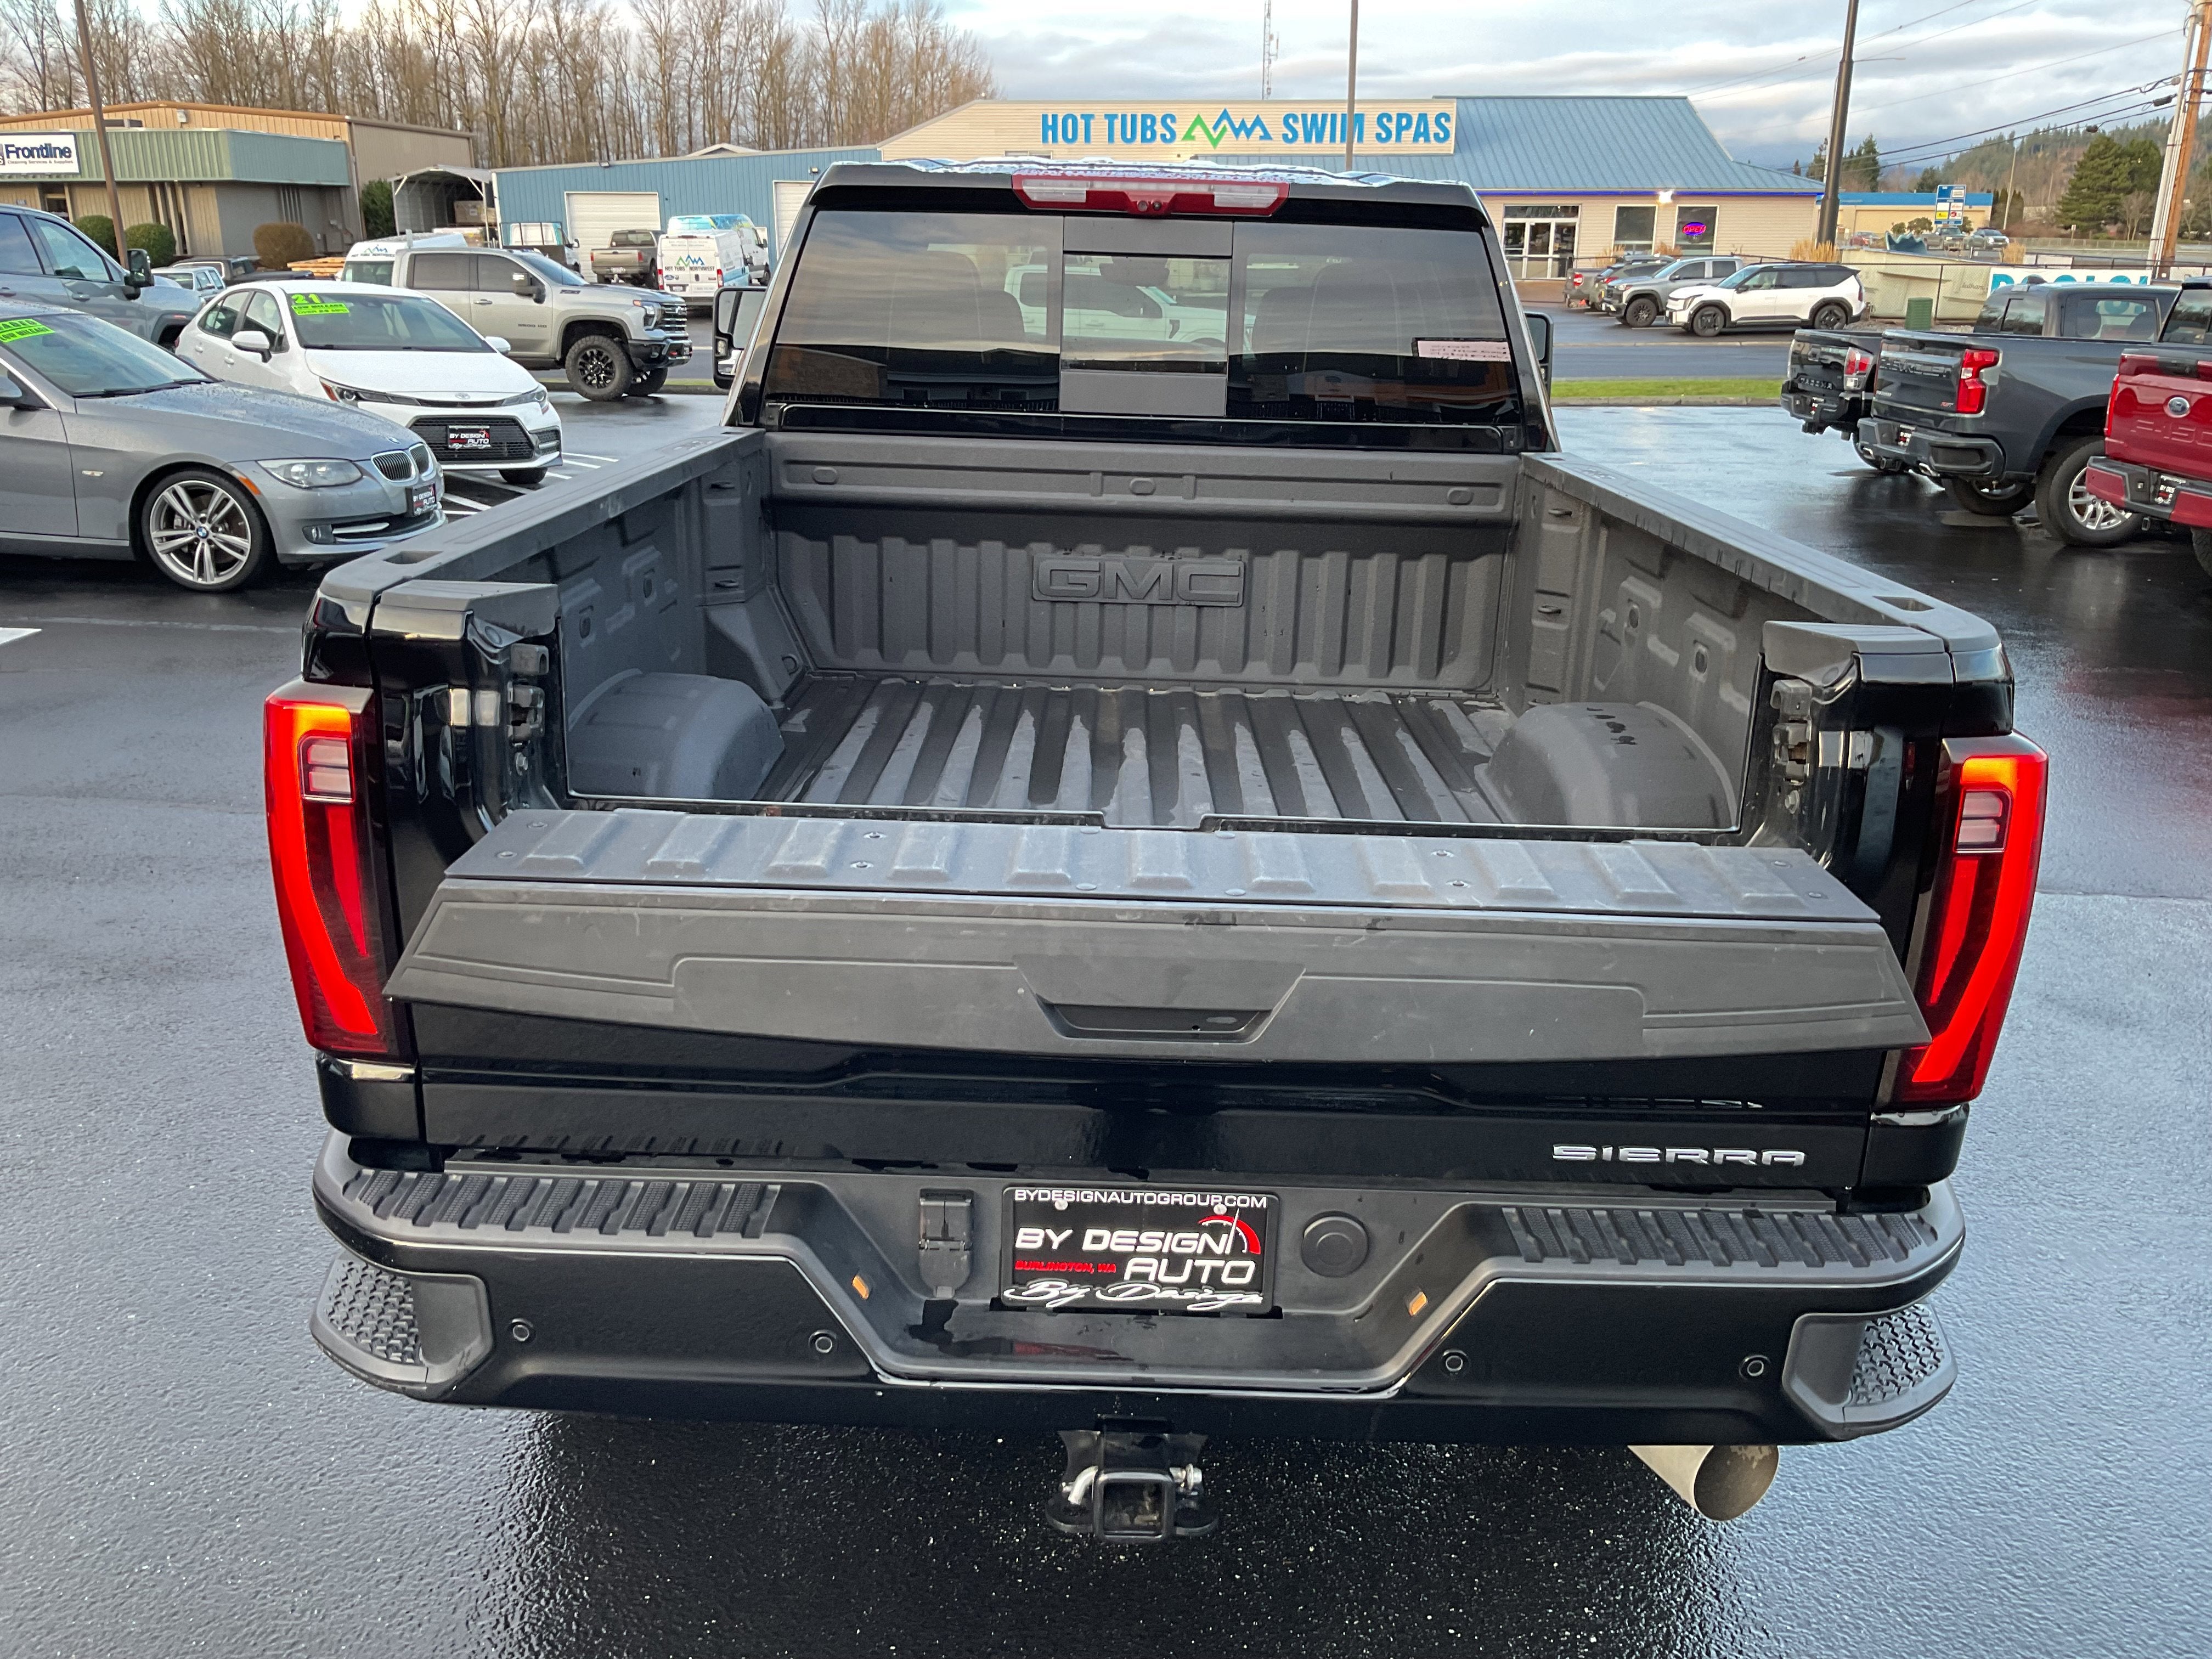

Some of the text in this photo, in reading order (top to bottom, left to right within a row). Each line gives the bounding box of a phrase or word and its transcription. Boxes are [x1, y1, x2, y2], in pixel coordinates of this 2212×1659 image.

[1042, 112, 1177, 144] HOT TUBS
[1282, 112, 1451, 144] SWIM SPAS
[1682, 225, 1706, 233] OPEN
[291, 294, 322, 304] 21
[1038, 559, 1240, 603] GMC
[1553, 1144, 1806, 1165] SIERRA
[1015, 1189, 1267, 1208] BYDESIGNAUTOGROUP.COM
[1015, 1227, 1229, 1255] BY DESIGN
[1015, 1260, 1117, 1274] BURLINGTON, WA
[1123, 1257, 1256, 1284] AUTO
[1003, 1280, 1091, 1308] By
